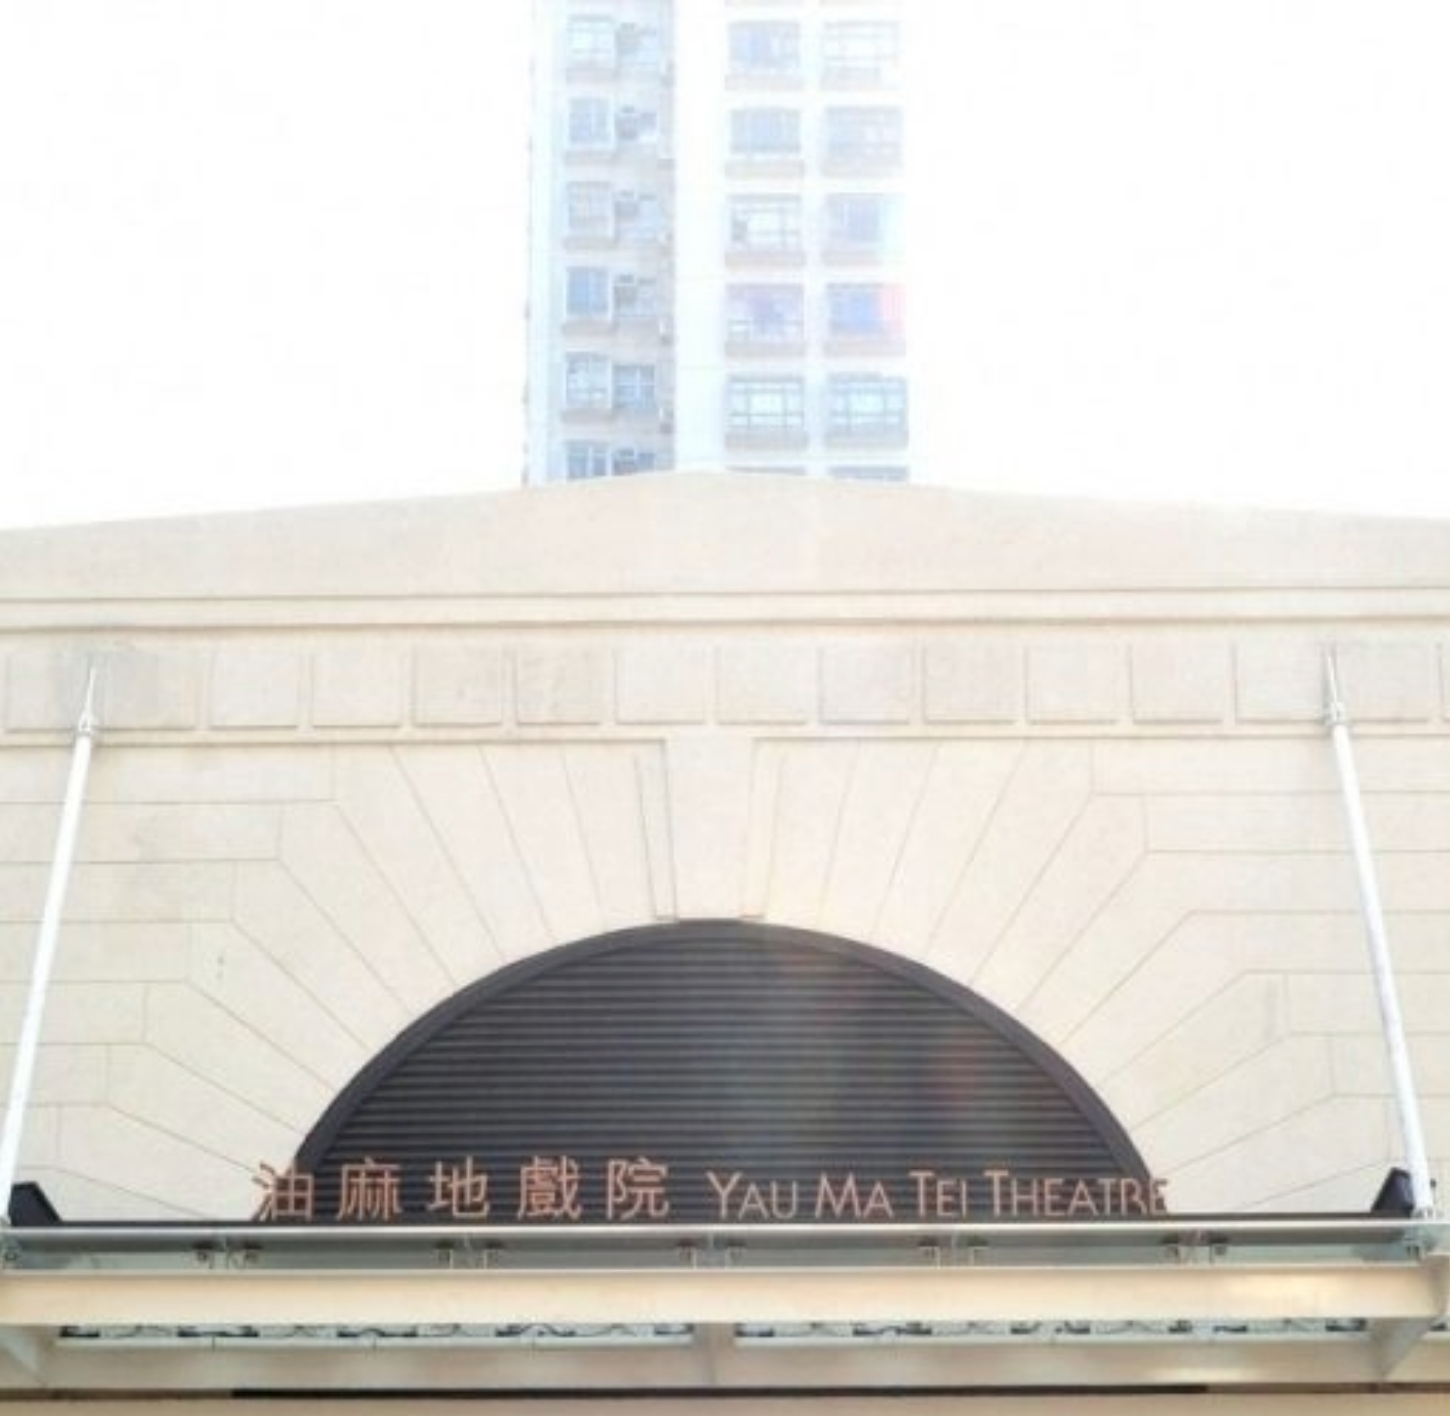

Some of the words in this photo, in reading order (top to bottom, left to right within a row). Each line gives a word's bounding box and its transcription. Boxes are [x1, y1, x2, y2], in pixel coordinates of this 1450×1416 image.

[252, 1155, 670, 1220] 油麻地戲院
[707, 1171, 798, 1220] YAU
[815, 1173, 894, 1219] MA
[985, 1170, 1168, 1217] THEATRE
